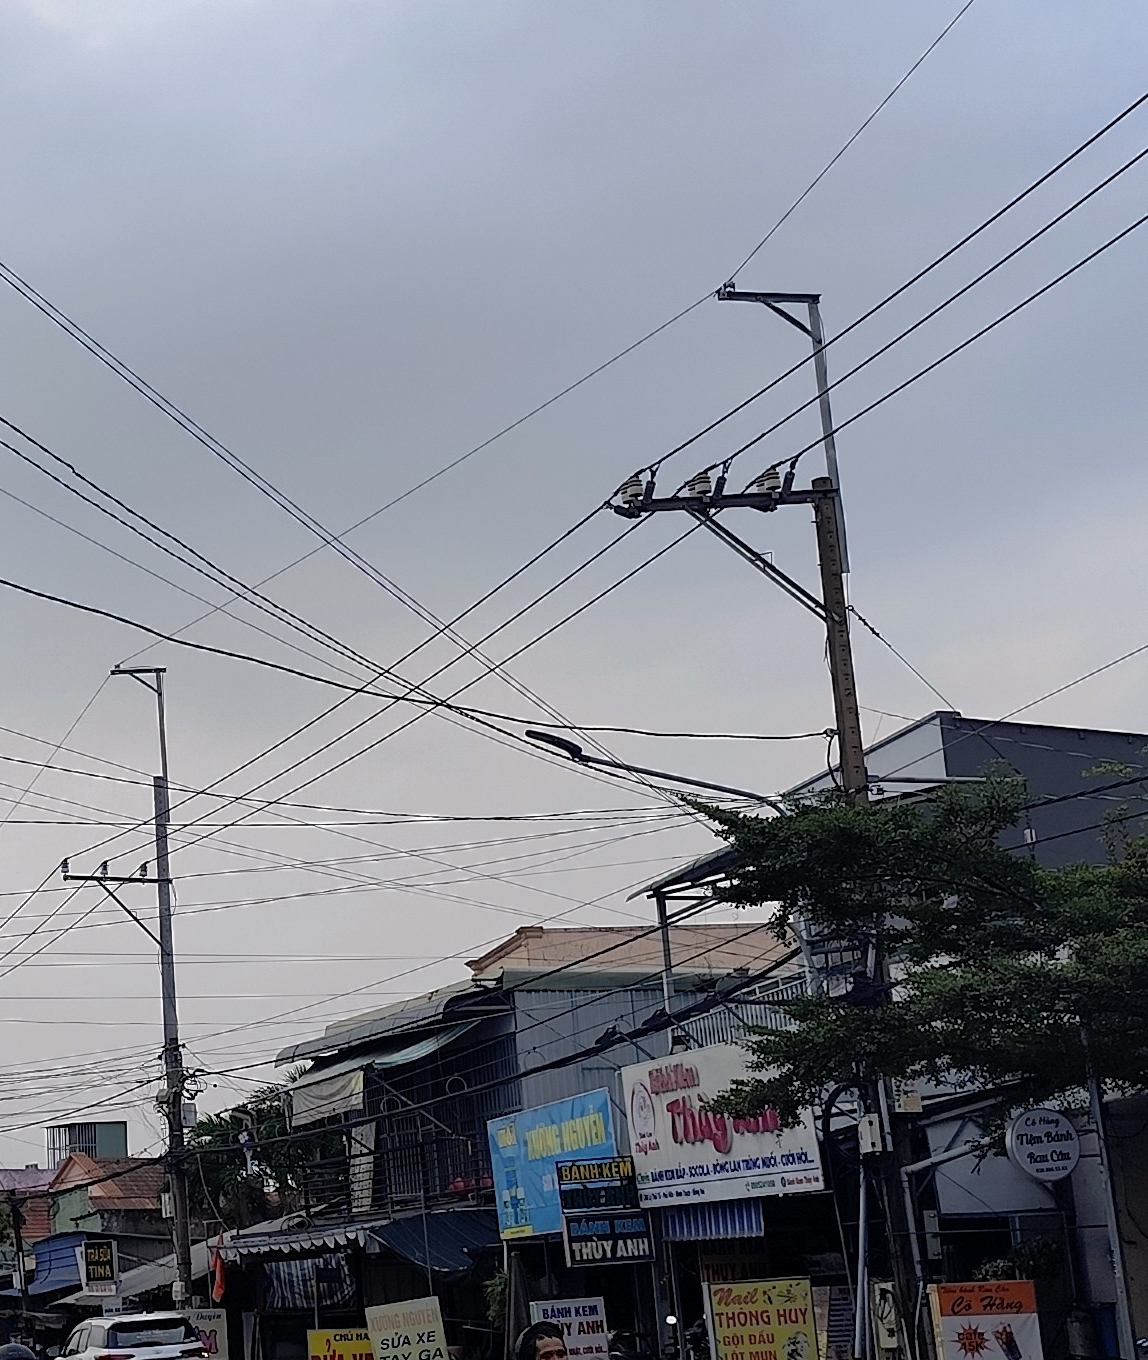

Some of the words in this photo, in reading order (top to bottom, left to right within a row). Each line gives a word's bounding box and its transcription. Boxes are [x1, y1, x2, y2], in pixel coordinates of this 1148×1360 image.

[1043, 1129, 1075, 1144] Bánh
[571, 1236, 614, 1261] THÙY
[615, 1237, 651, 1258] ANH
[88, 1264, 113, 1279] TINA
[713, 1287, 759, 1307] Nail
[951, 1295, 973, 1315] Cô
[541, 1304, 572, 1320] BÁNH
[573, 1304, 600, 1317] KEM
[715, 1307, 771, 1329] THÔNG
[776, 1307, 808, 1326] HUY
[333, 1330, 354, 1342] CHÚ
[577, 1319, 605, 1336] ANH
[380, 1331, 413, 1351] SỬA
[416, 1330, 437, 1345] XE
[748, 1329, 775, 1346] ĐẦU
